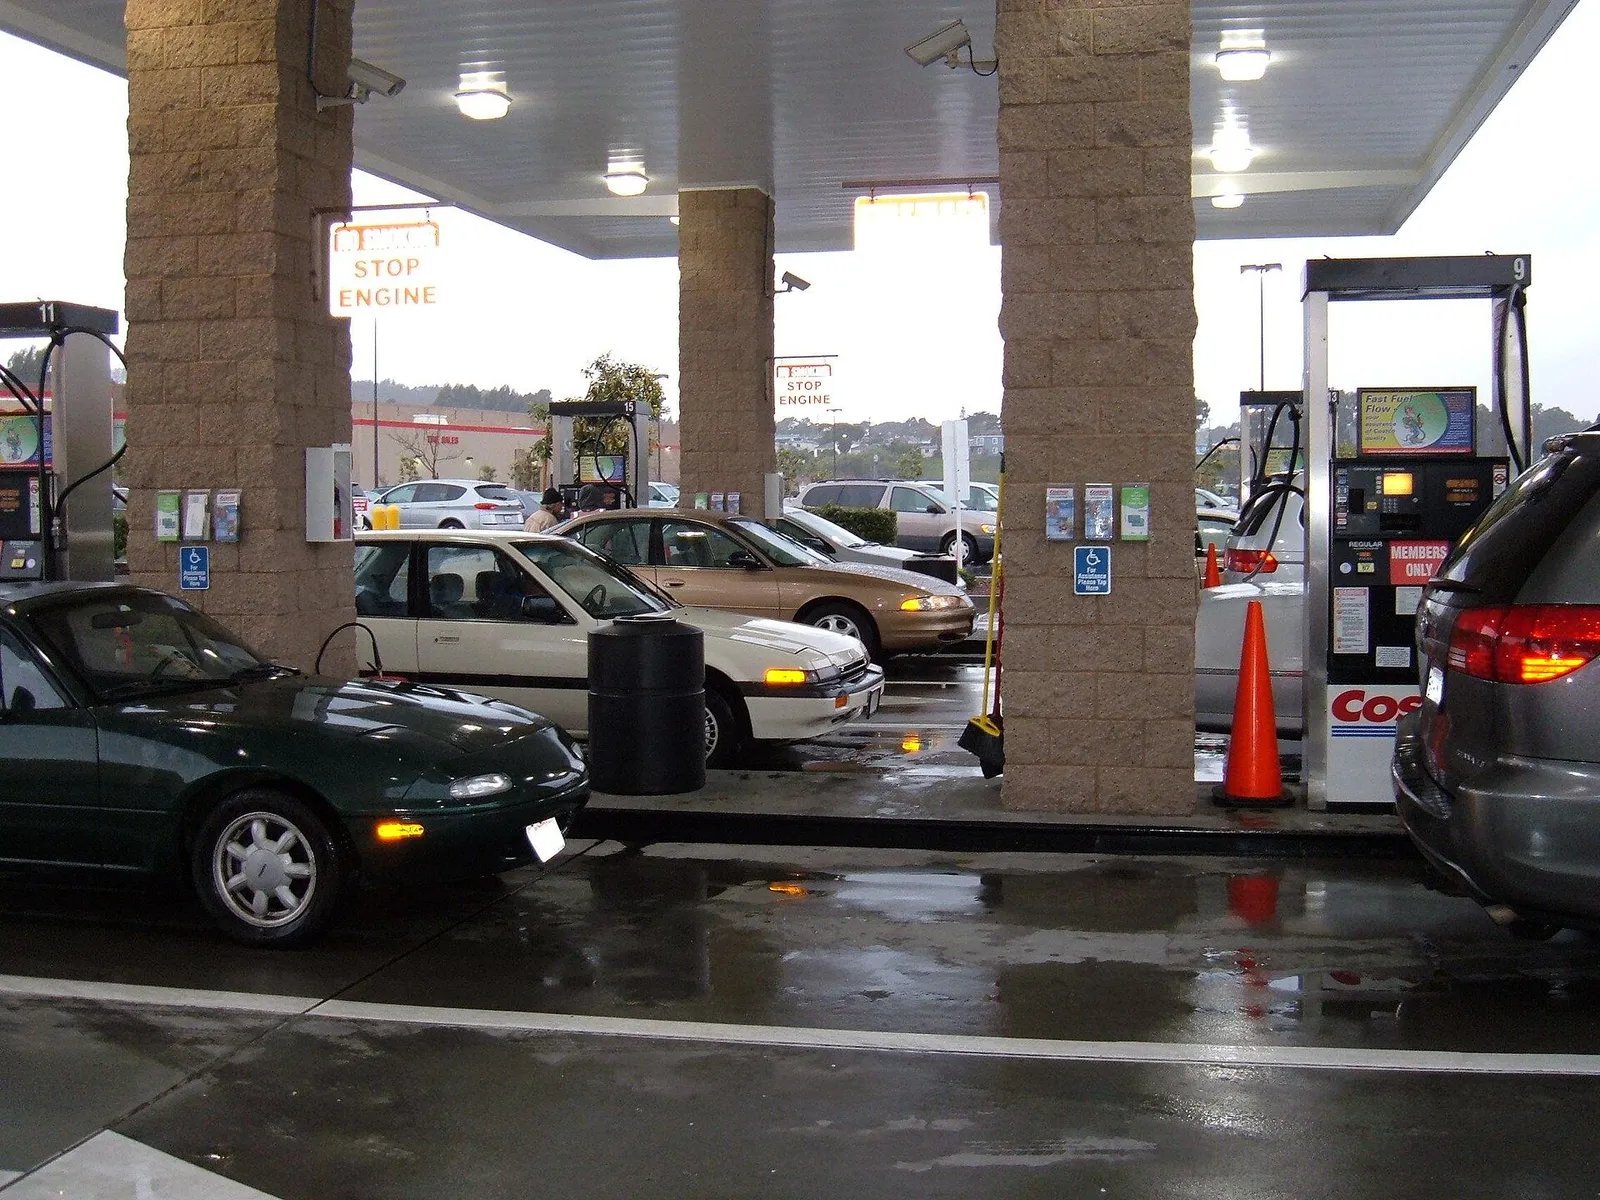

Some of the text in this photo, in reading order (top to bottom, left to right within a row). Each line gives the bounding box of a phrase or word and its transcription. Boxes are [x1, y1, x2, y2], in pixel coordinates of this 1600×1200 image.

[354, 258, 420, 278] STOP
[1513, 257, 1525, 280] 9
[339, 286, 437, 308] ENGINE
[39, 303, 55, 323] 11
[787, 381, 822, 391] STOP
[779, 395, 831, 405] ENGINE
[1365, 394, 1414, 403] Fast Fuel
[624, 401, 634, 412] 15
[1365, 404, 1391, 413] Flow
[1390, 545, 1448, 560] MEMBERS
[1405, 563, 1433, 577] ONLY
